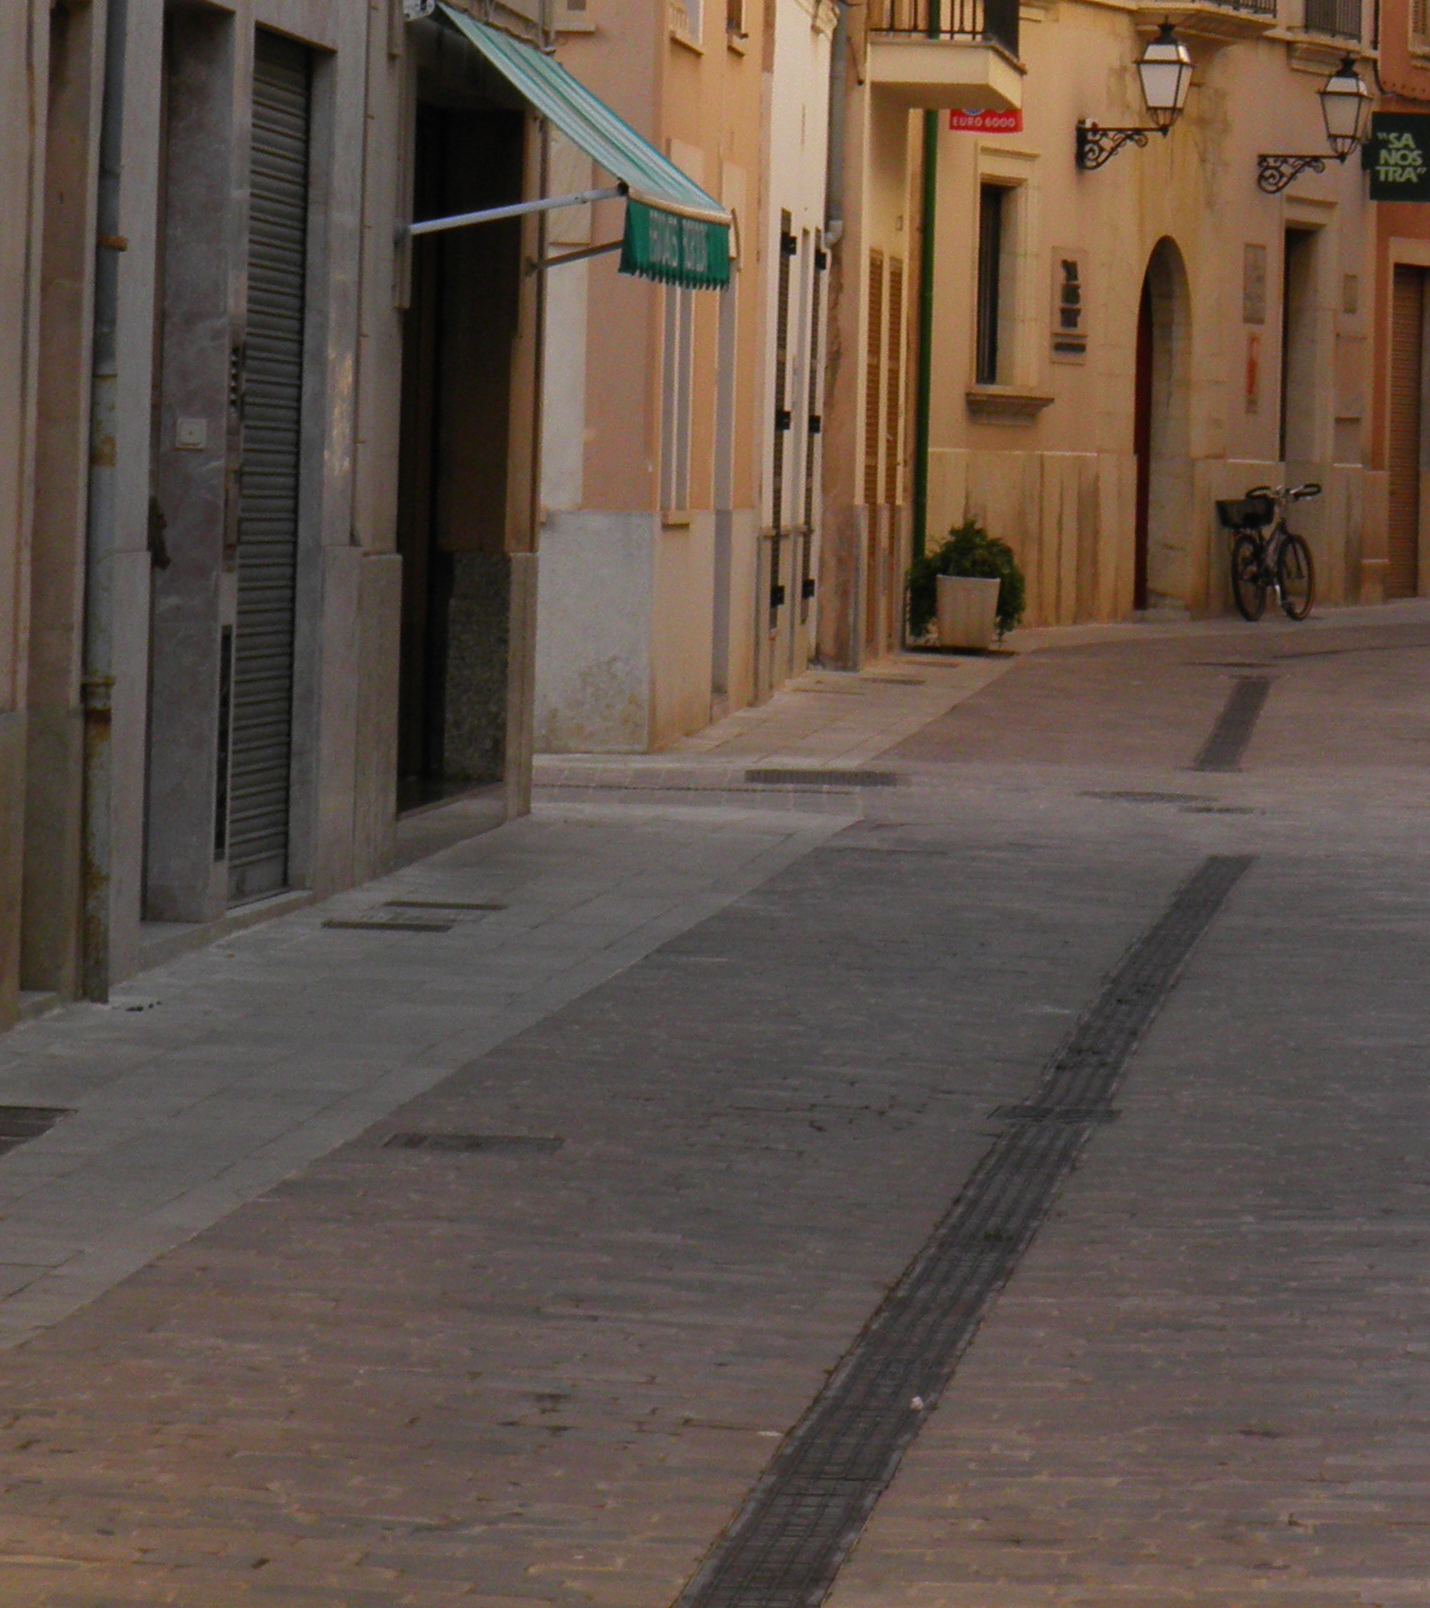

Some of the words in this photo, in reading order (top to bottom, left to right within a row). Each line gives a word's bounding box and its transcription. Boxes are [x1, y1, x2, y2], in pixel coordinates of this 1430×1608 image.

[952, 116, 983, 127] EURO
[985, 117, 1016, 128] 6000
[1379, 150, 1423, 166] NOS
